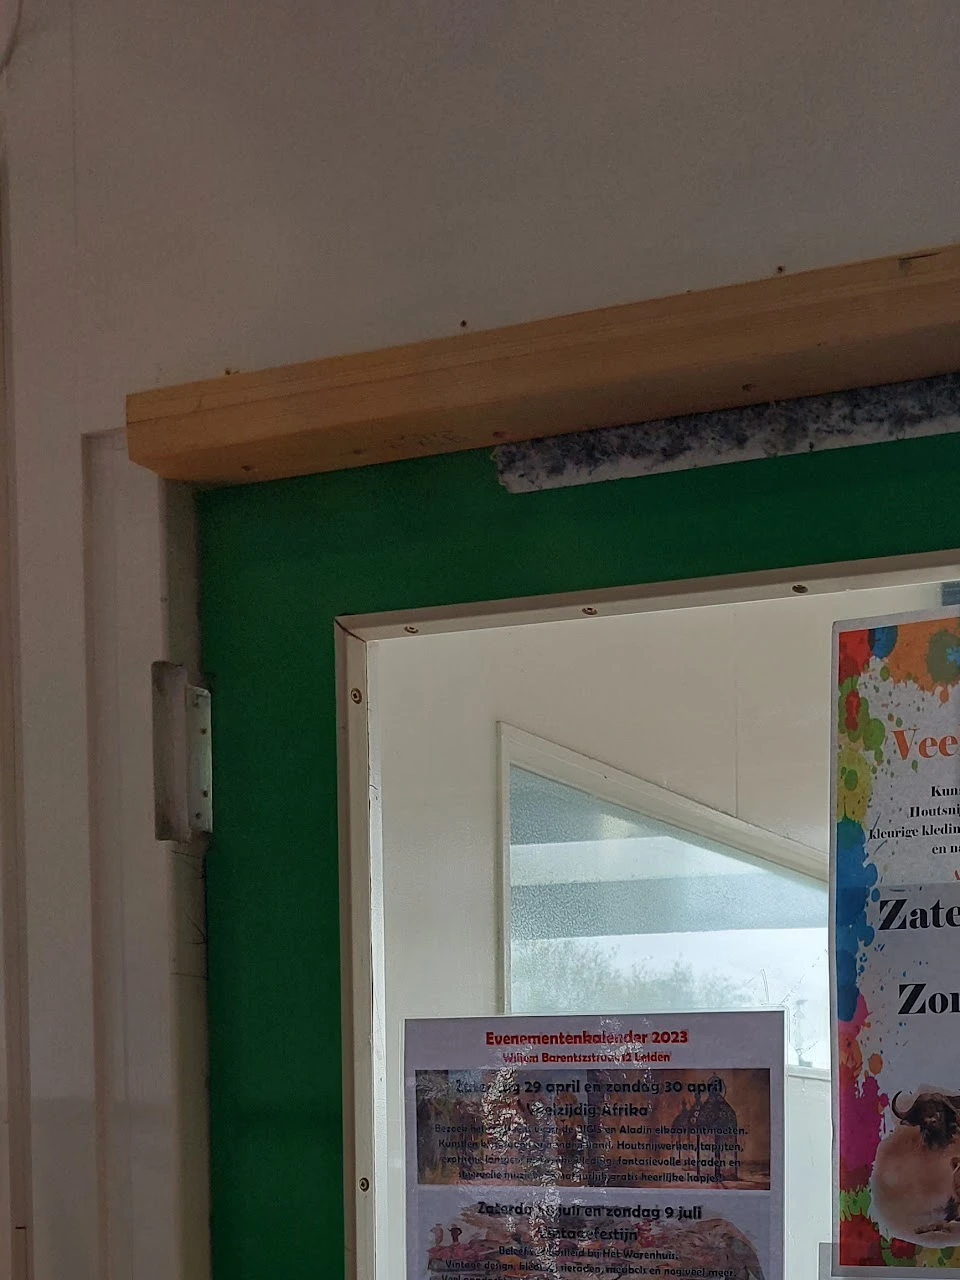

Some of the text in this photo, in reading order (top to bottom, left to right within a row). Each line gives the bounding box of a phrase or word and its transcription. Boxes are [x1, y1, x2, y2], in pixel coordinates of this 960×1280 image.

[869, 826, 919, 841] kleurige
[931, 845, 946, 855] en
[486, 1030, 688, 1045] Evenementenkalender 2023
[524, 1080, 540, 1093] 29
[546, 1079, 580, 1096] april
[584, 1082, 601, 1093] en
[606, 1079, 660, 1095] zondag
[664, 1081, 682, 1093] 30
[688, 1080, 722, 1097] april
[602, 1102, 648, 1117] Afrika
[557, 1204, 580, 1220] juli
[584, 1207, 601, 1217] en
[605, 1204, 660, 1220] zondag
[664, 1206, 674, 1218] 9
[678, 1205, 702, 1221] juli
